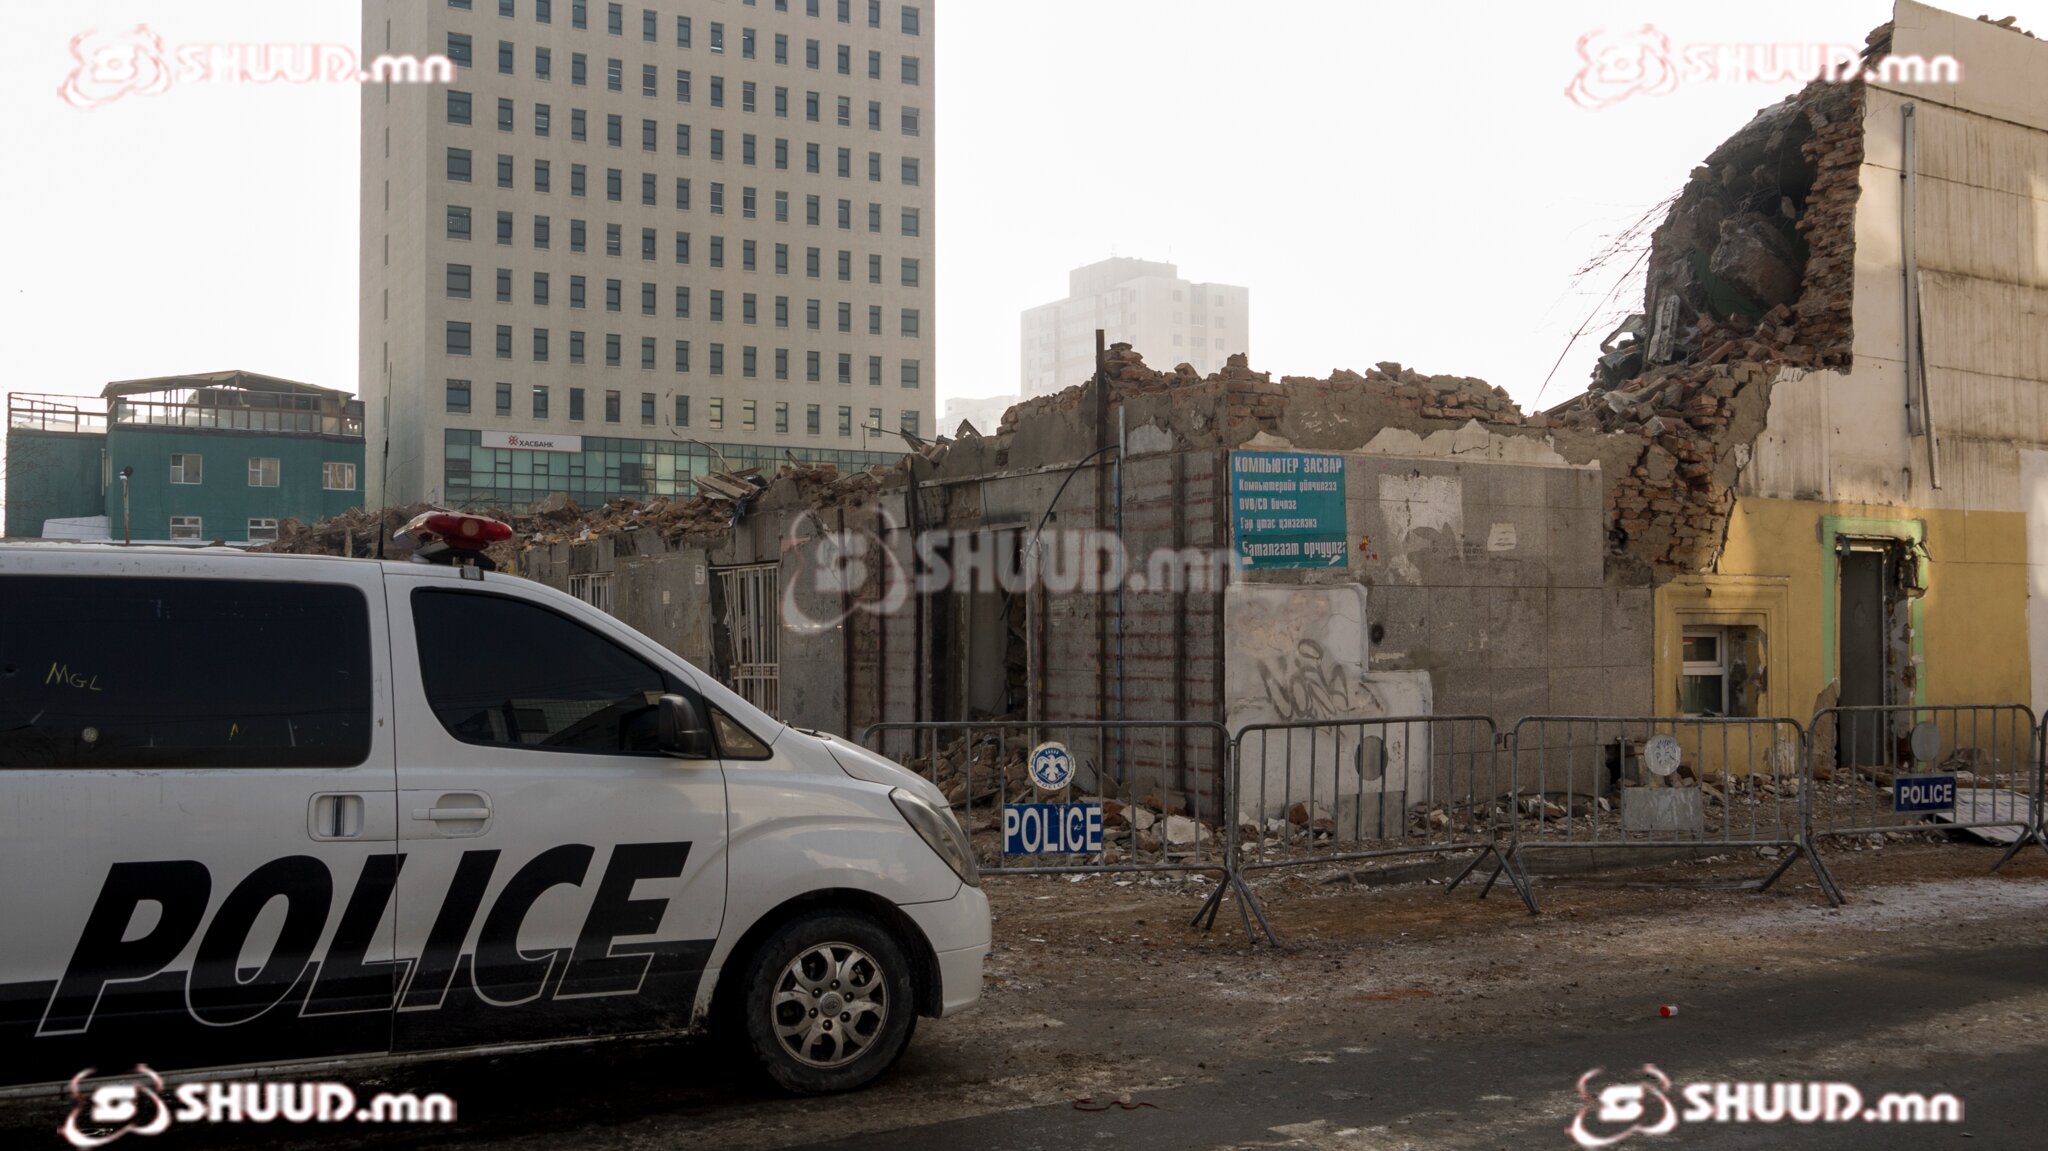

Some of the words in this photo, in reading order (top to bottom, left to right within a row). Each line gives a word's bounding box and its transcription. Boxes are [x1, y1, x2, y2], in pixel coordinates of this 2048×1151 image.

[519, 440, 554, 448] ХАСБАНК
[1235, 456, 1298, 473] КОМПЬЮТЕР
[1303, 457, 1342, 473] ЗАСВАР
[1239, 479, 1296, 493] Компьютерийн
[1239, 498, 1268, 512] DVD/CD
[46, 661, 102, 691] MGL
[1900, 784, 1953, 804] POLICE
[1004, 807, 1102, 852] POLICE
[35, 841, 694, 1037] POLICE
